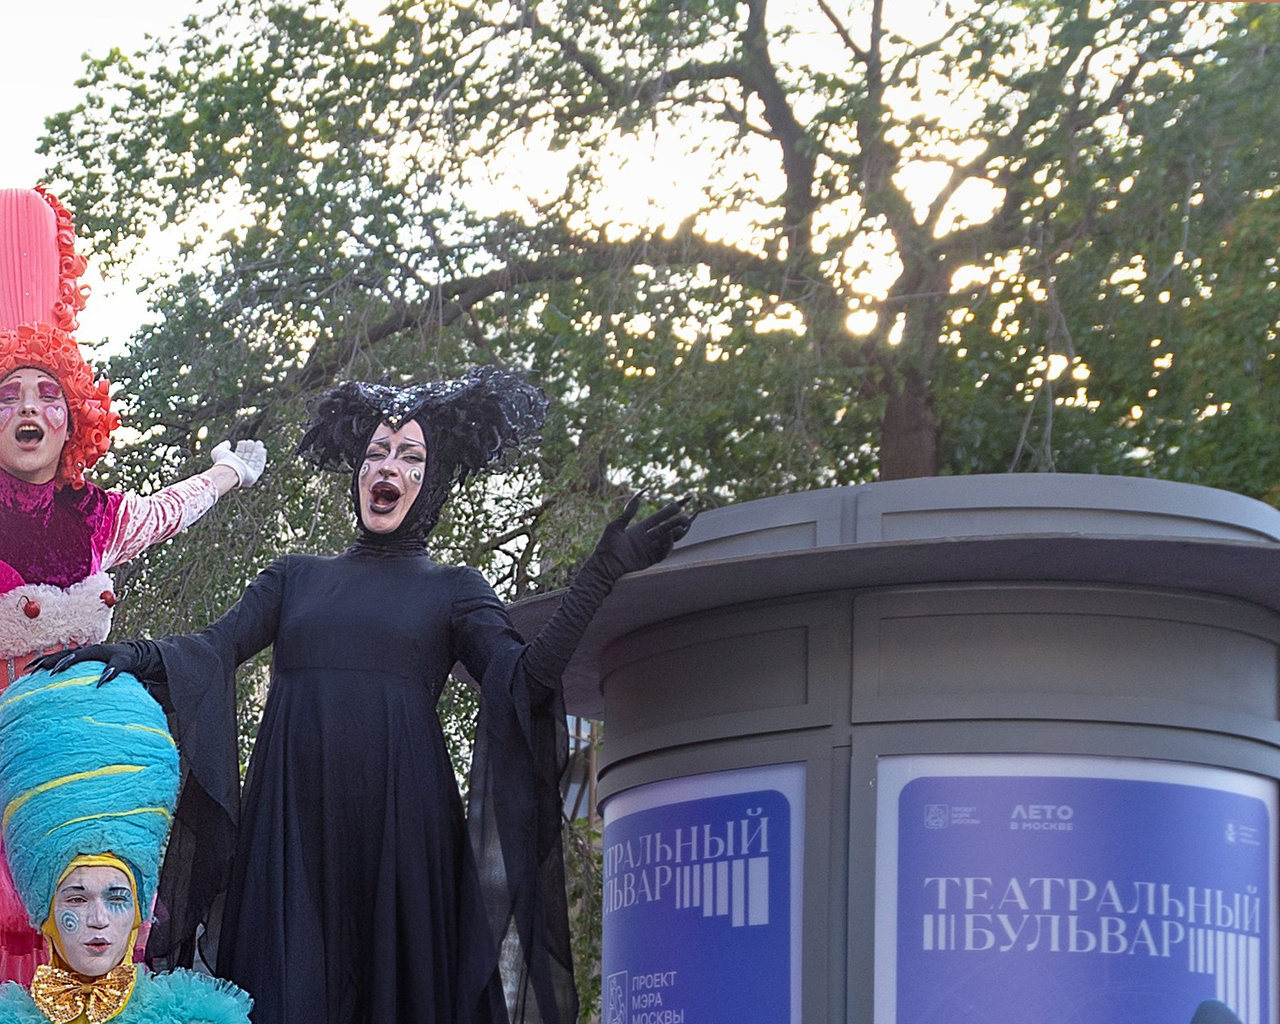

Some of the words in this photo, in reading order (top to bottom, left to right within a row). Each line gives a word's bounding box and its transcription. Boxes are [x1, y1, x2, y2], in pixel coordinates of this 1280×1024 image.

[1011, 804, 1074, 820] ЛЕТО
[1010, 822, 1019, 830] В
[1022, 822, 1073, 831] МОСКВЕ
[604, 864, 673, 915] ЛЬВАР
[923, 877, 1262, 933] ТЕАТРАЛЬНЫЙ
[964, 913, 1185, 957] БУЛЬВАР
[631, 971, 677, 991] ПРОЕКТ
[631, 995, 663, 1010] МЭРА
